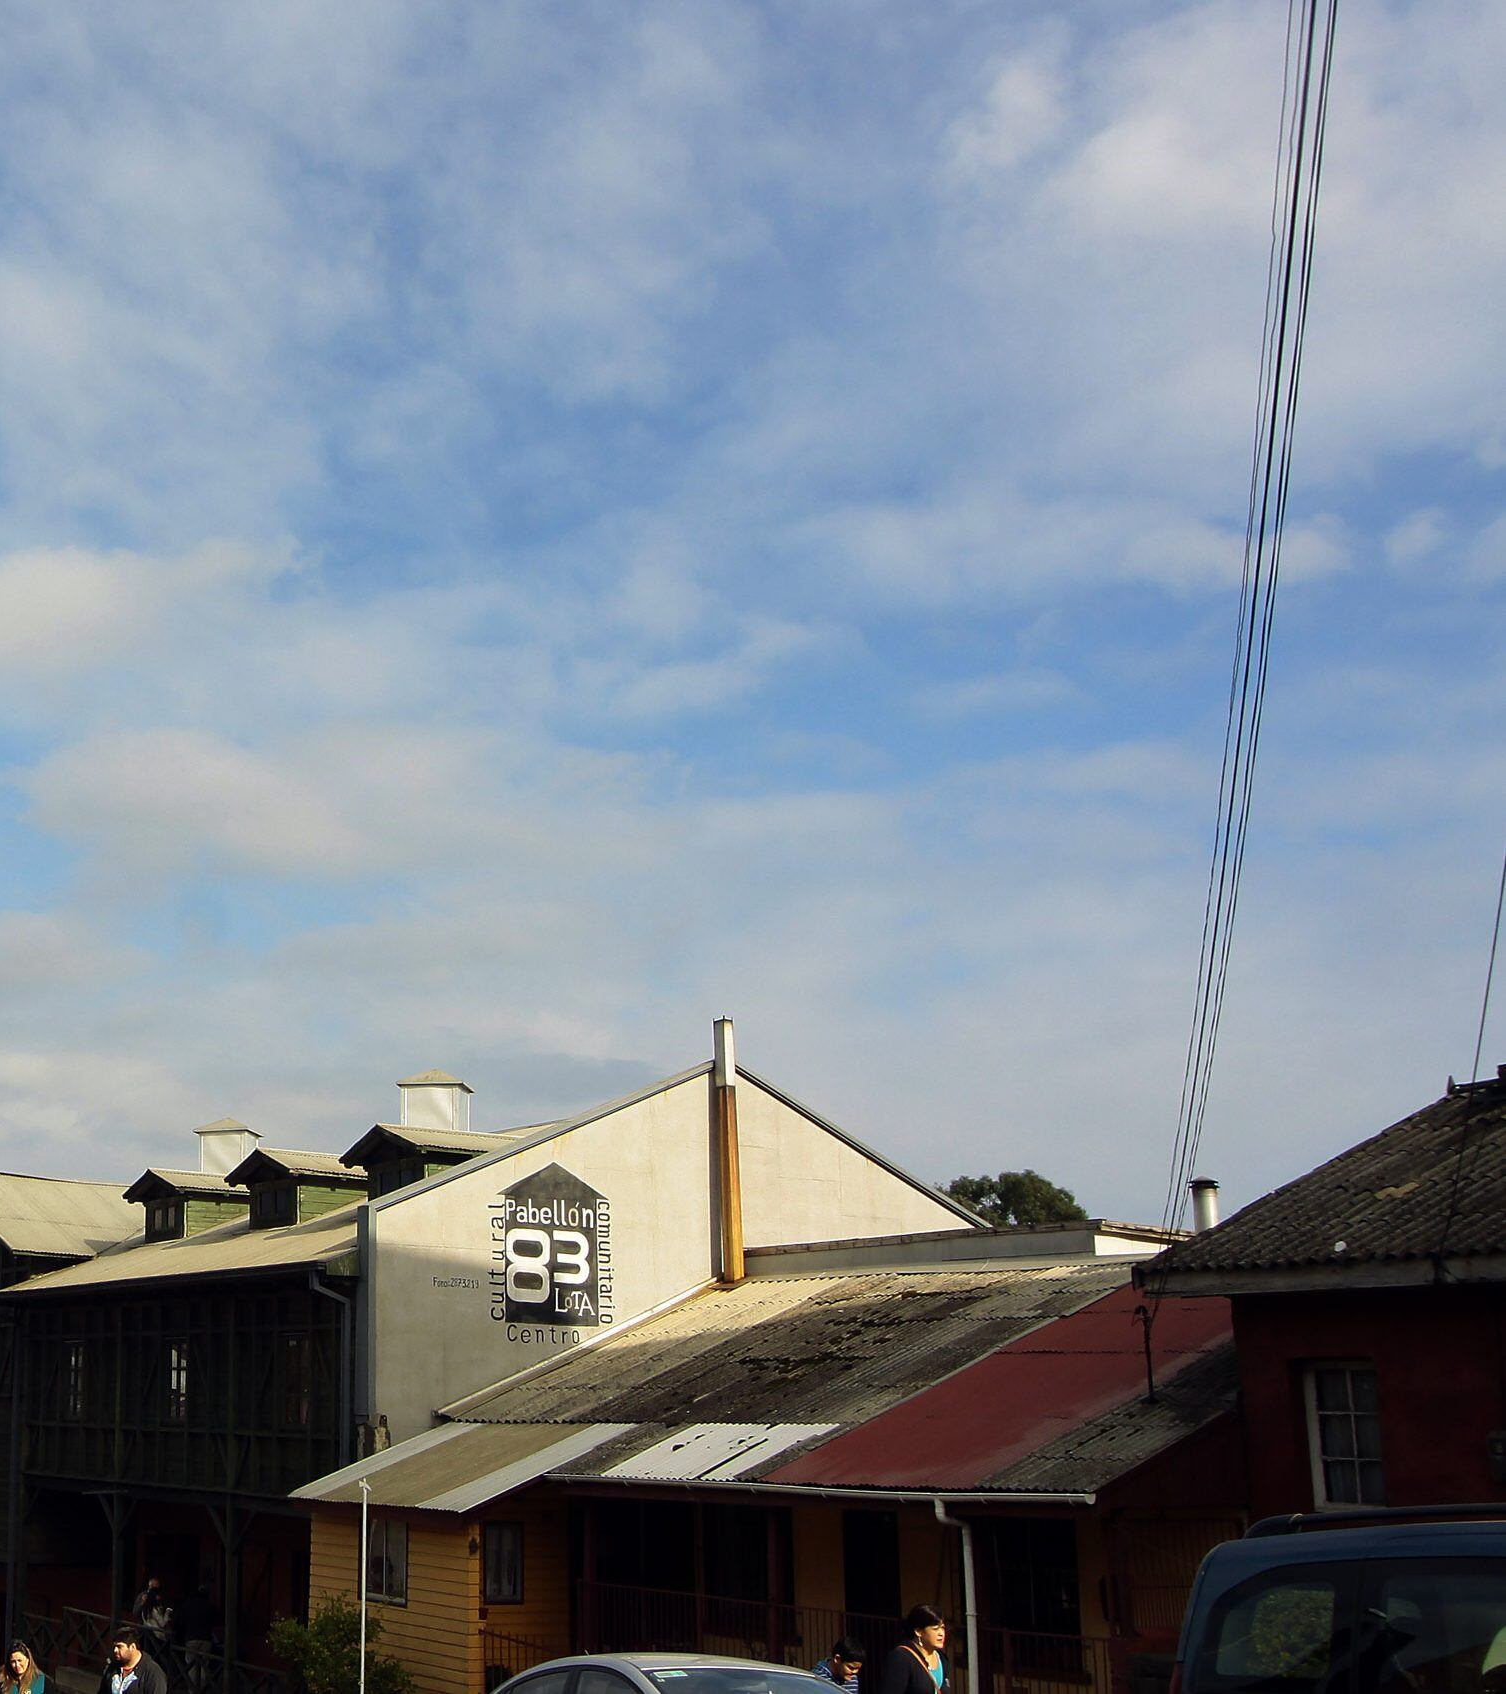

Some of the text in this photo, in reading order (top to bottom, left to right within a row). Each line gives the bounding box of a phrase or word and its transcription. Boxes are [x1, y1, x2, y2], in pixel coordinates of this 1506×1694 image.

[505, 1198, 594, 1228] Pabellón
[487, 1203, 505, 1321] cultural
[505, 1227, 590, 1304] 83
[597, 1200, 615, 1325] comunitario
[506, 1324, 580, 1344] Centro
